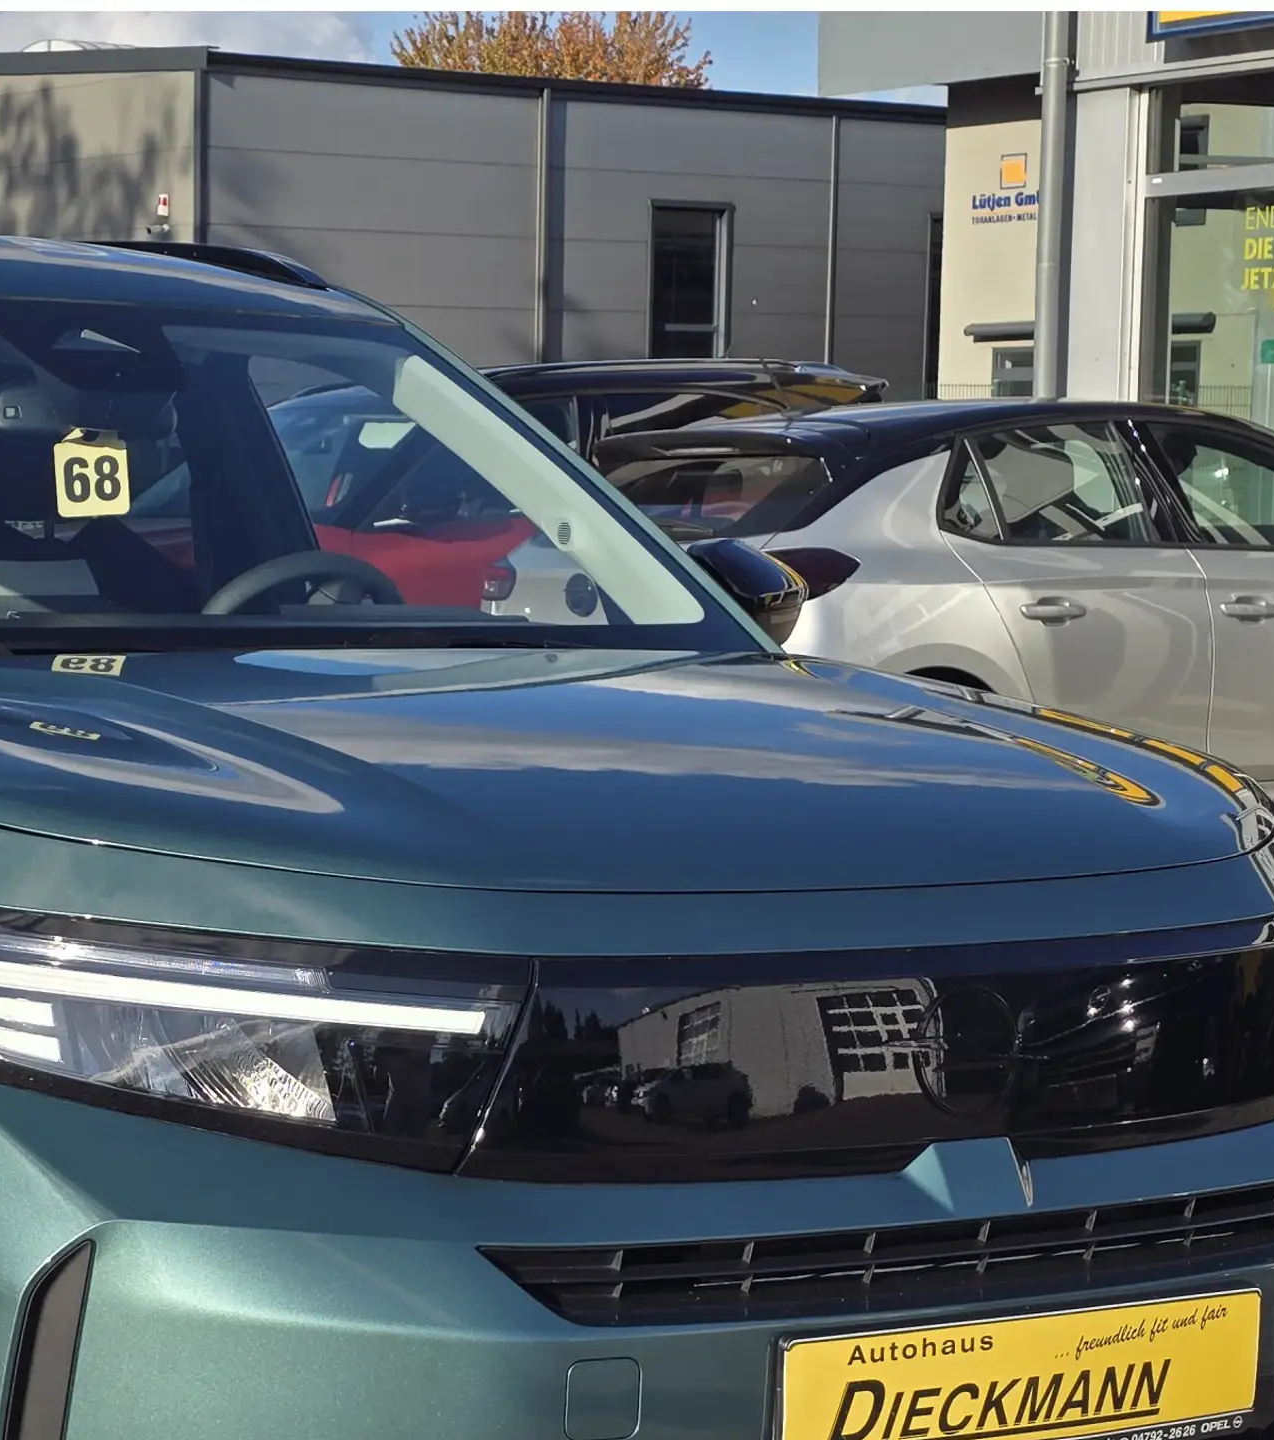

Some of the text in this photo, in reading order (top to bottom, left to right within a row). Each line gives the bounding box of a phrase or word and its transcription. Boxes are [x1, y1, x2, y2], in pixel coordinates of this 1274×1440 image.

[972, 193, 1011, 211] Lütjen
[1244, 236, 1274, 260] DIE
[63, 454, 121, 503] 68
[1075, 1318, 1146, 1361] freundlich
[1149, 1318, 1168, 1343] fit
[1172, 1308, 1199, 1330] und
[1200, 1304, 1229, 1331] fair
[847, 1335, 994, 1366] Autohaus
[1200, 1420, 1231, 1435] OPEL
